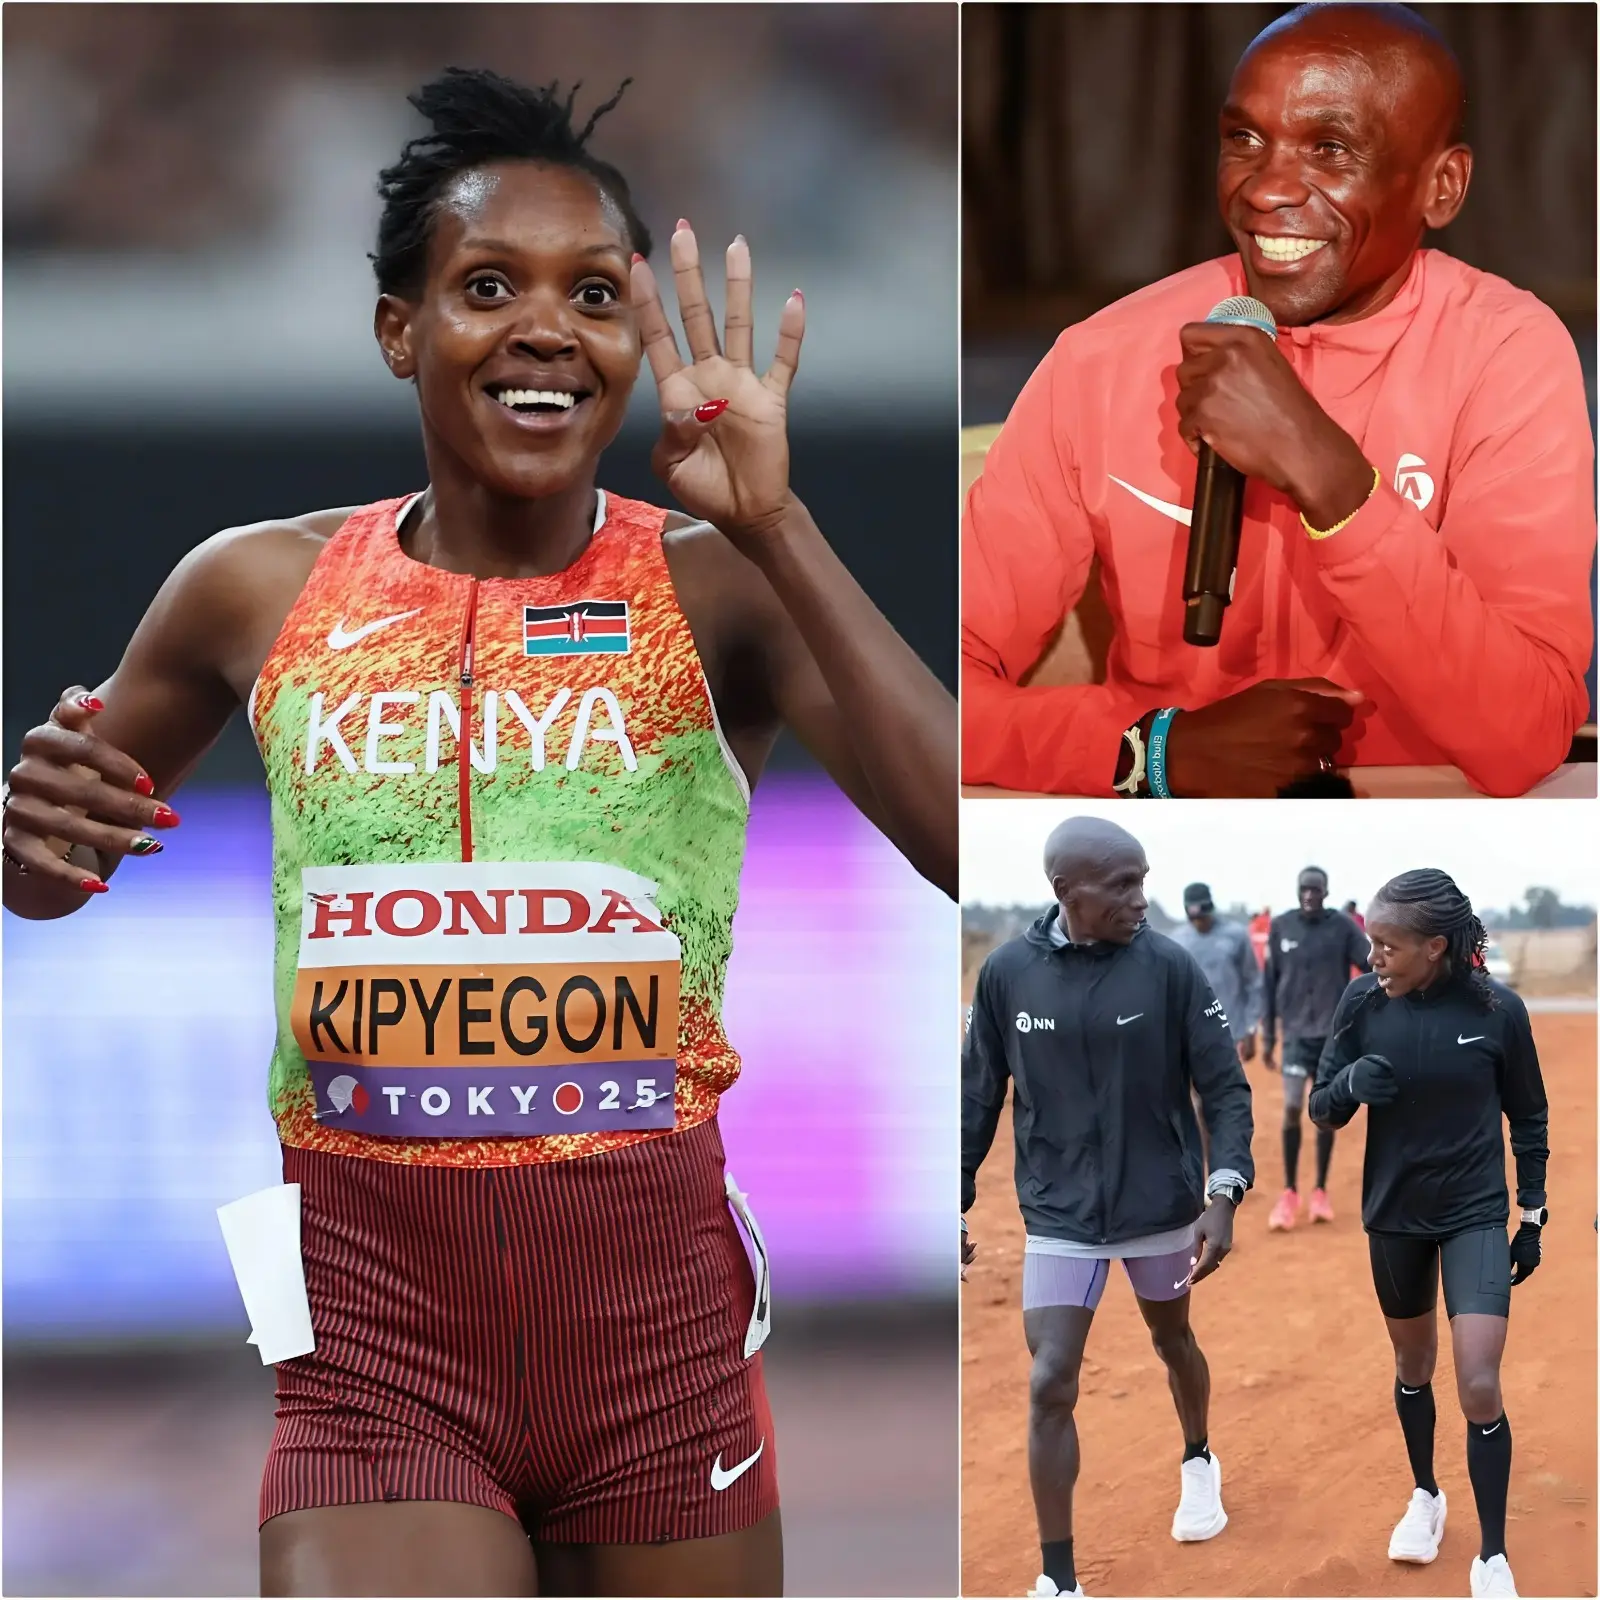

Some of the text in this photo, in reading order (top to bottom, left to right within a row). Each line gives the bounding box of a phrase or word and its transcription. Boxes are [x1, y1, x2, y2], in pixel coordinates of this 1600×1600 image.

[304, 687, 638, 776] KENYA
[307, 888, 667, 940] HONDA
[309, 974, 659, 1056] KIPYEGON
